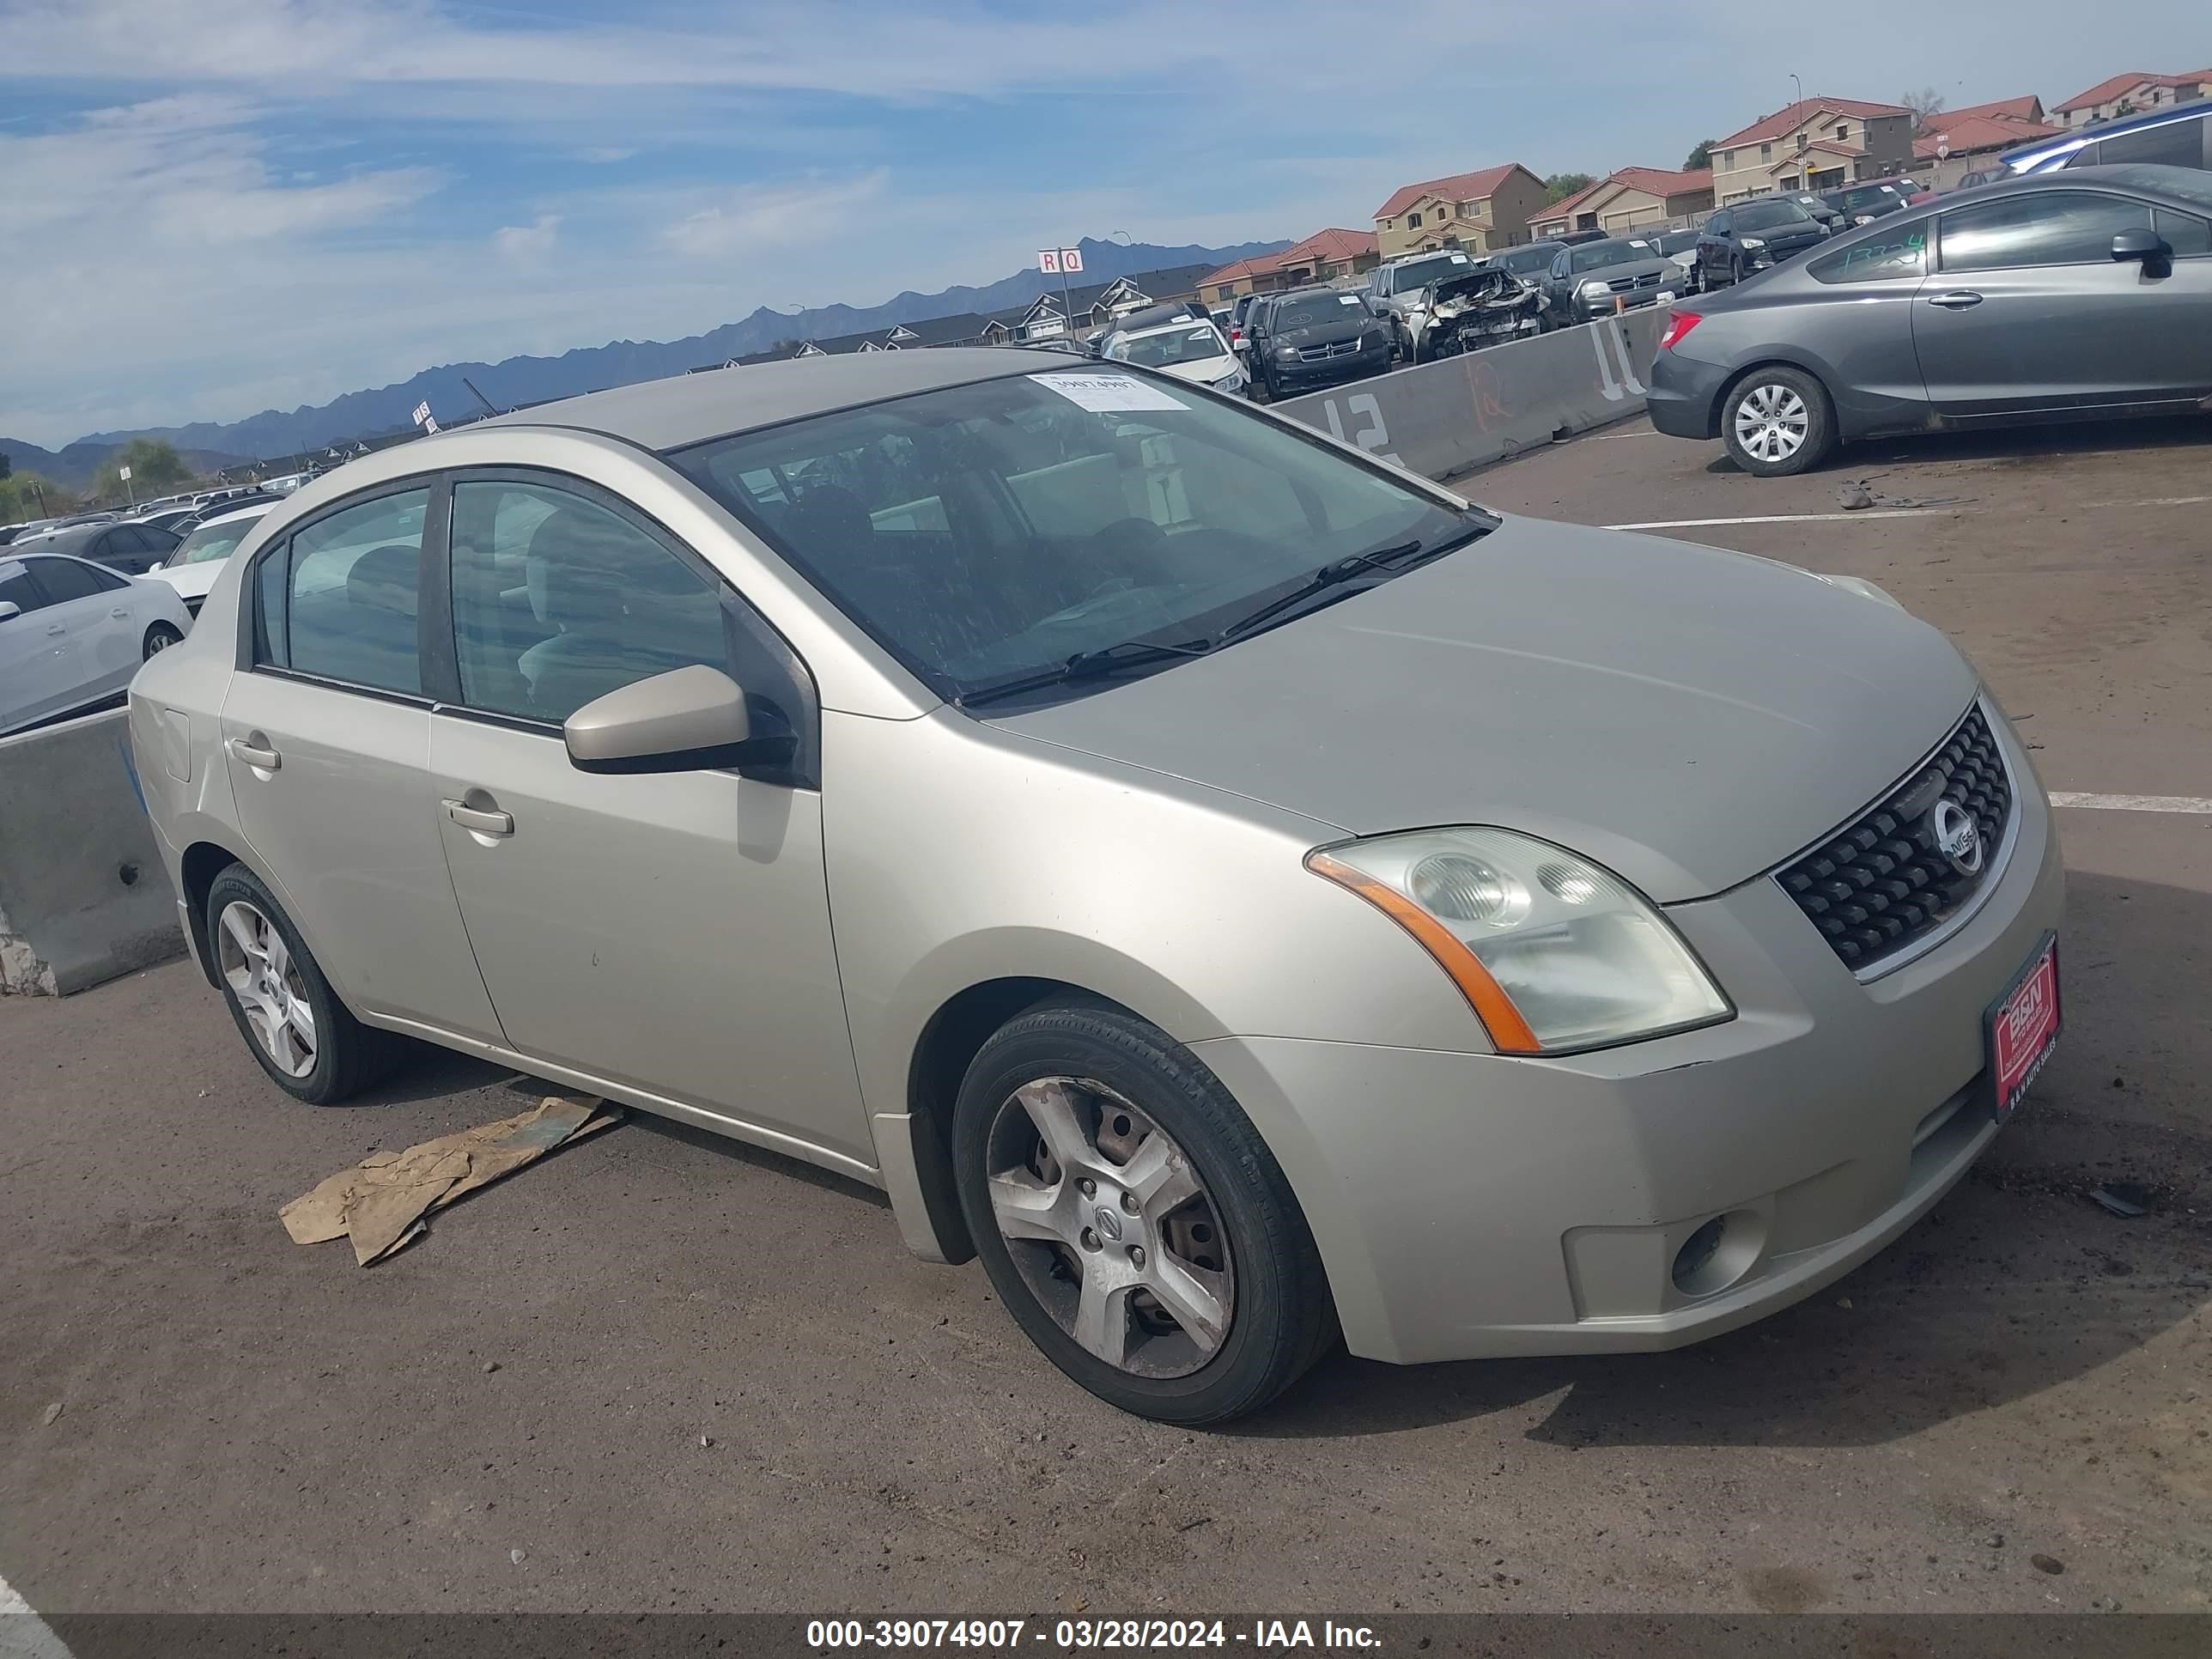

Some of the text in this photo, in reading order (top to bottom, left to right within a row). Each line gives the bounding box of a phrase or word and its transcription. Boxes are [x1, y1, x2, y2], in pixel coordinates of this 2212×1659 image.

[1043, 252, 1079, 270] R Q
[414, 404, 428, 422] T S
[427, 419, 436, 431] 10
[1950, 828, 1975, 854] NISS
[2009, 975, 2042, 1042] B&N
[2011, 1025, 2027, 1054] AUTO
[2026, 1002, 2043, 1031] SALES
[2010, 1036, 2056, 1111] B & N AUTO SALES
